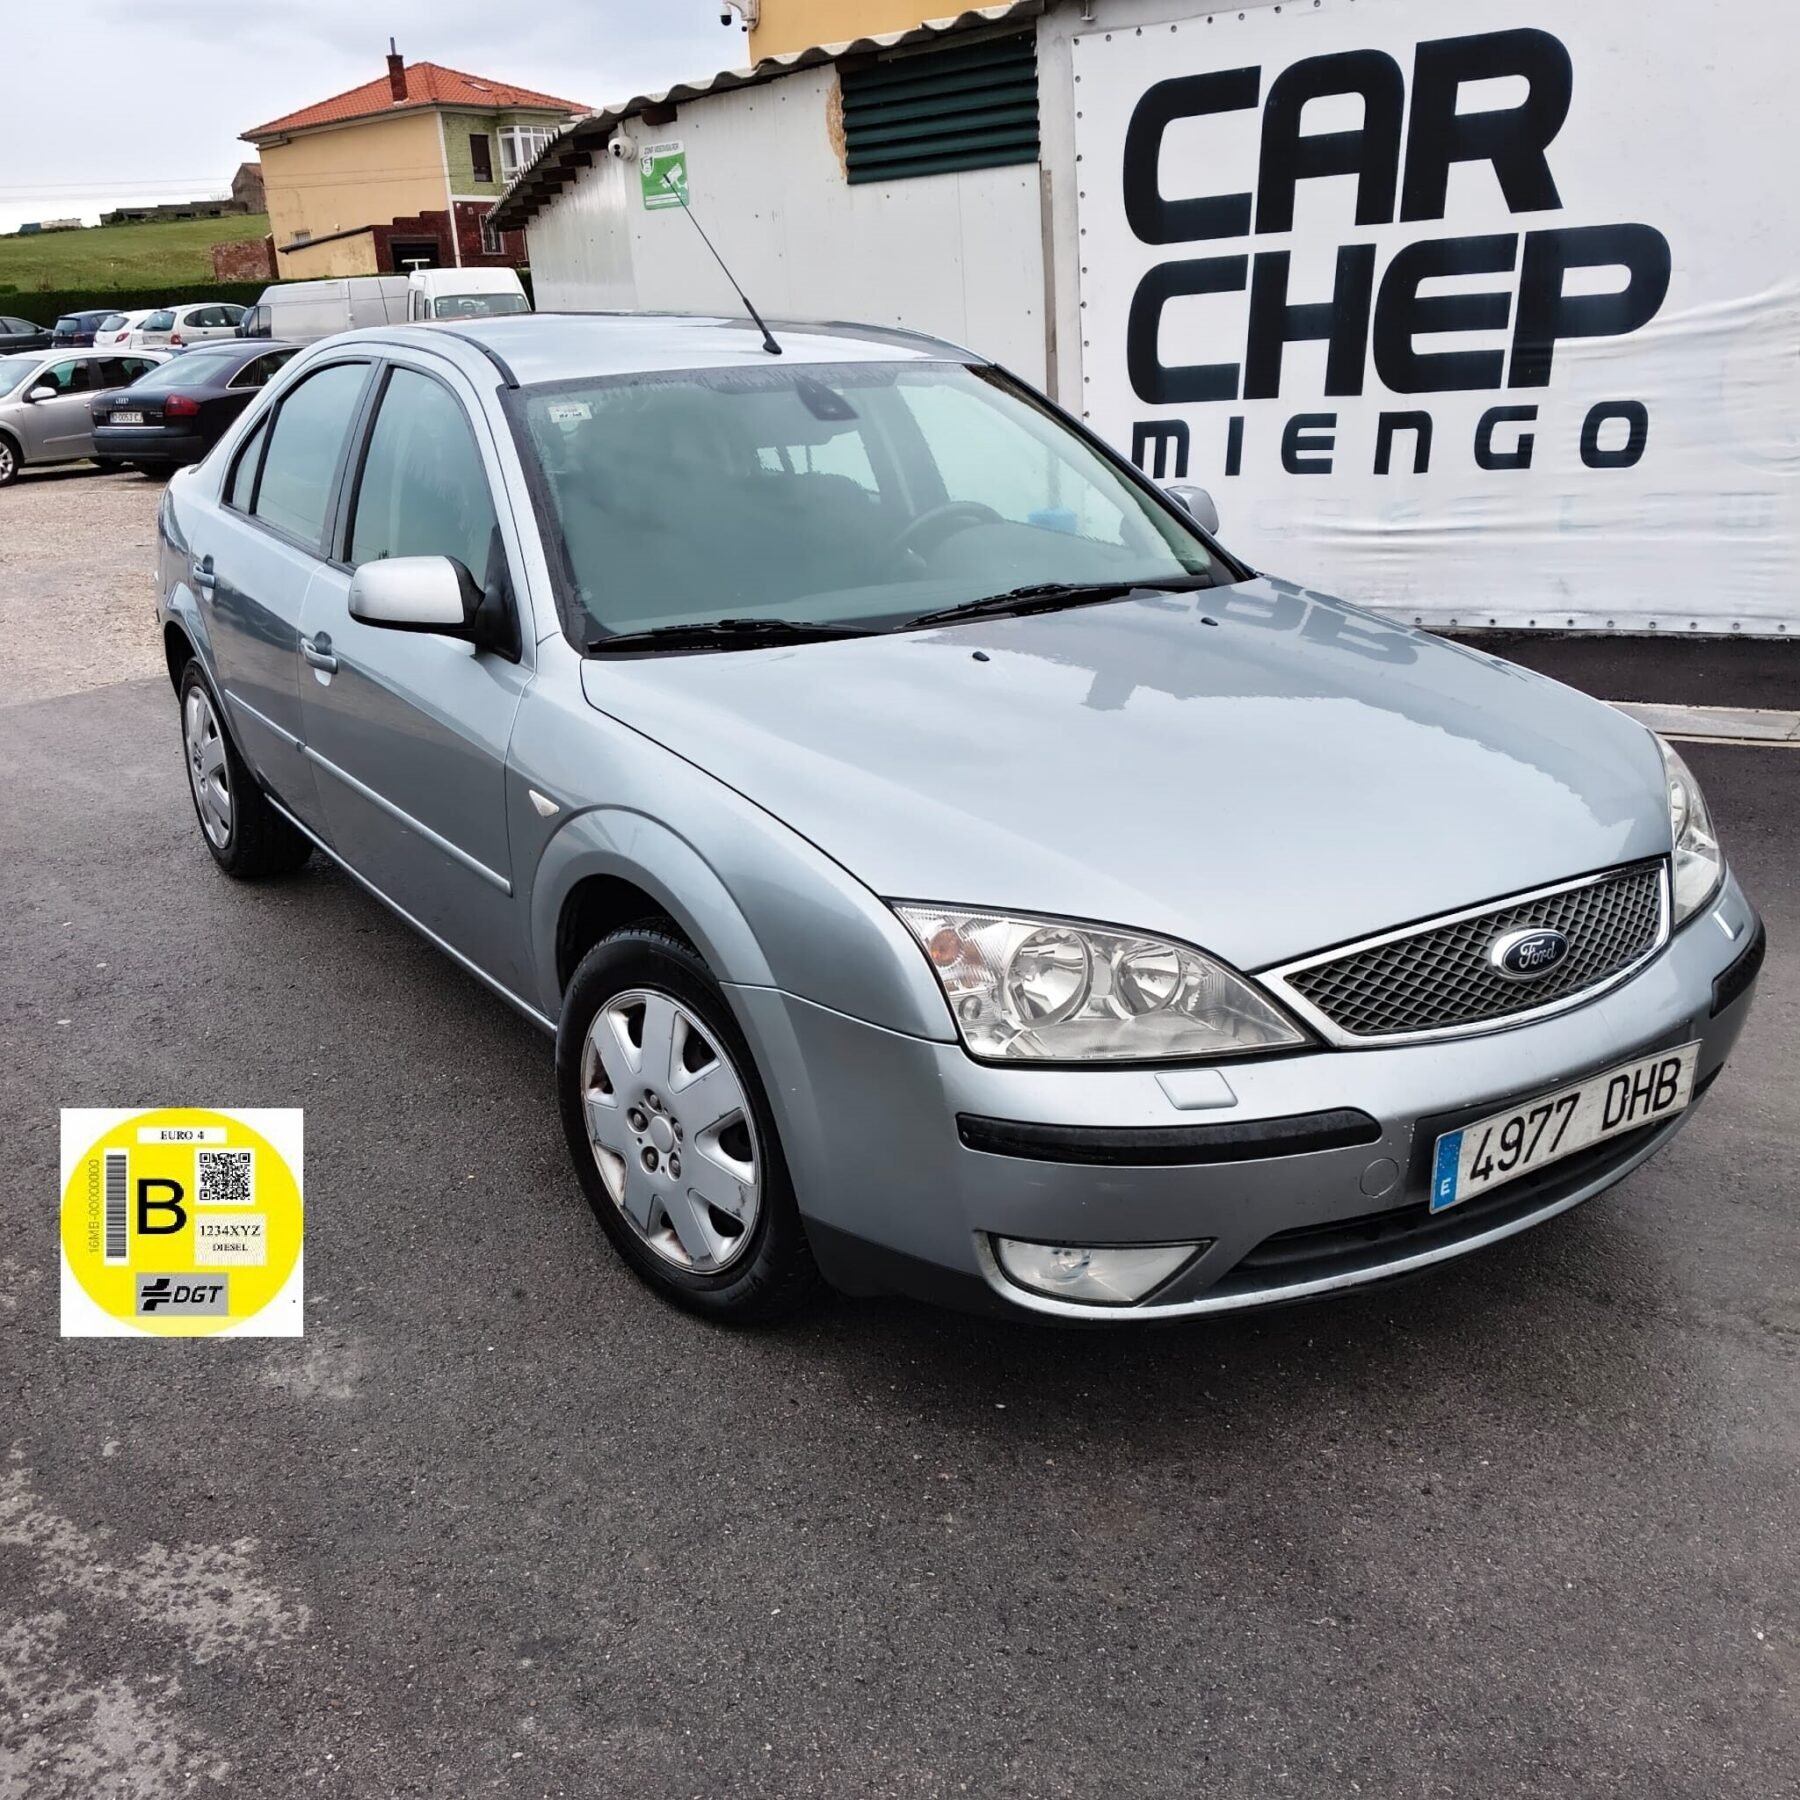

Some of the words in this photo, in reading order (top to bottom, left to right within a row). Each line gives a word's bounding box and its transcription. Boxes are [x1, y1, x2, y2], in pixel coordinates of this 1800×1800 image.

[1123, 27, 1573, 245] CAR
[1127, 222, 1671, 404] CHEP
[1131, 400, 1649, 479] MIENGO
[1518, 938, 1557, 969] Ford
[1440, 1176, 1452, 1196] E
[1469, 1091, 1581, 1181] 4977
[1601, 1057, 1681, 1132] DHB
